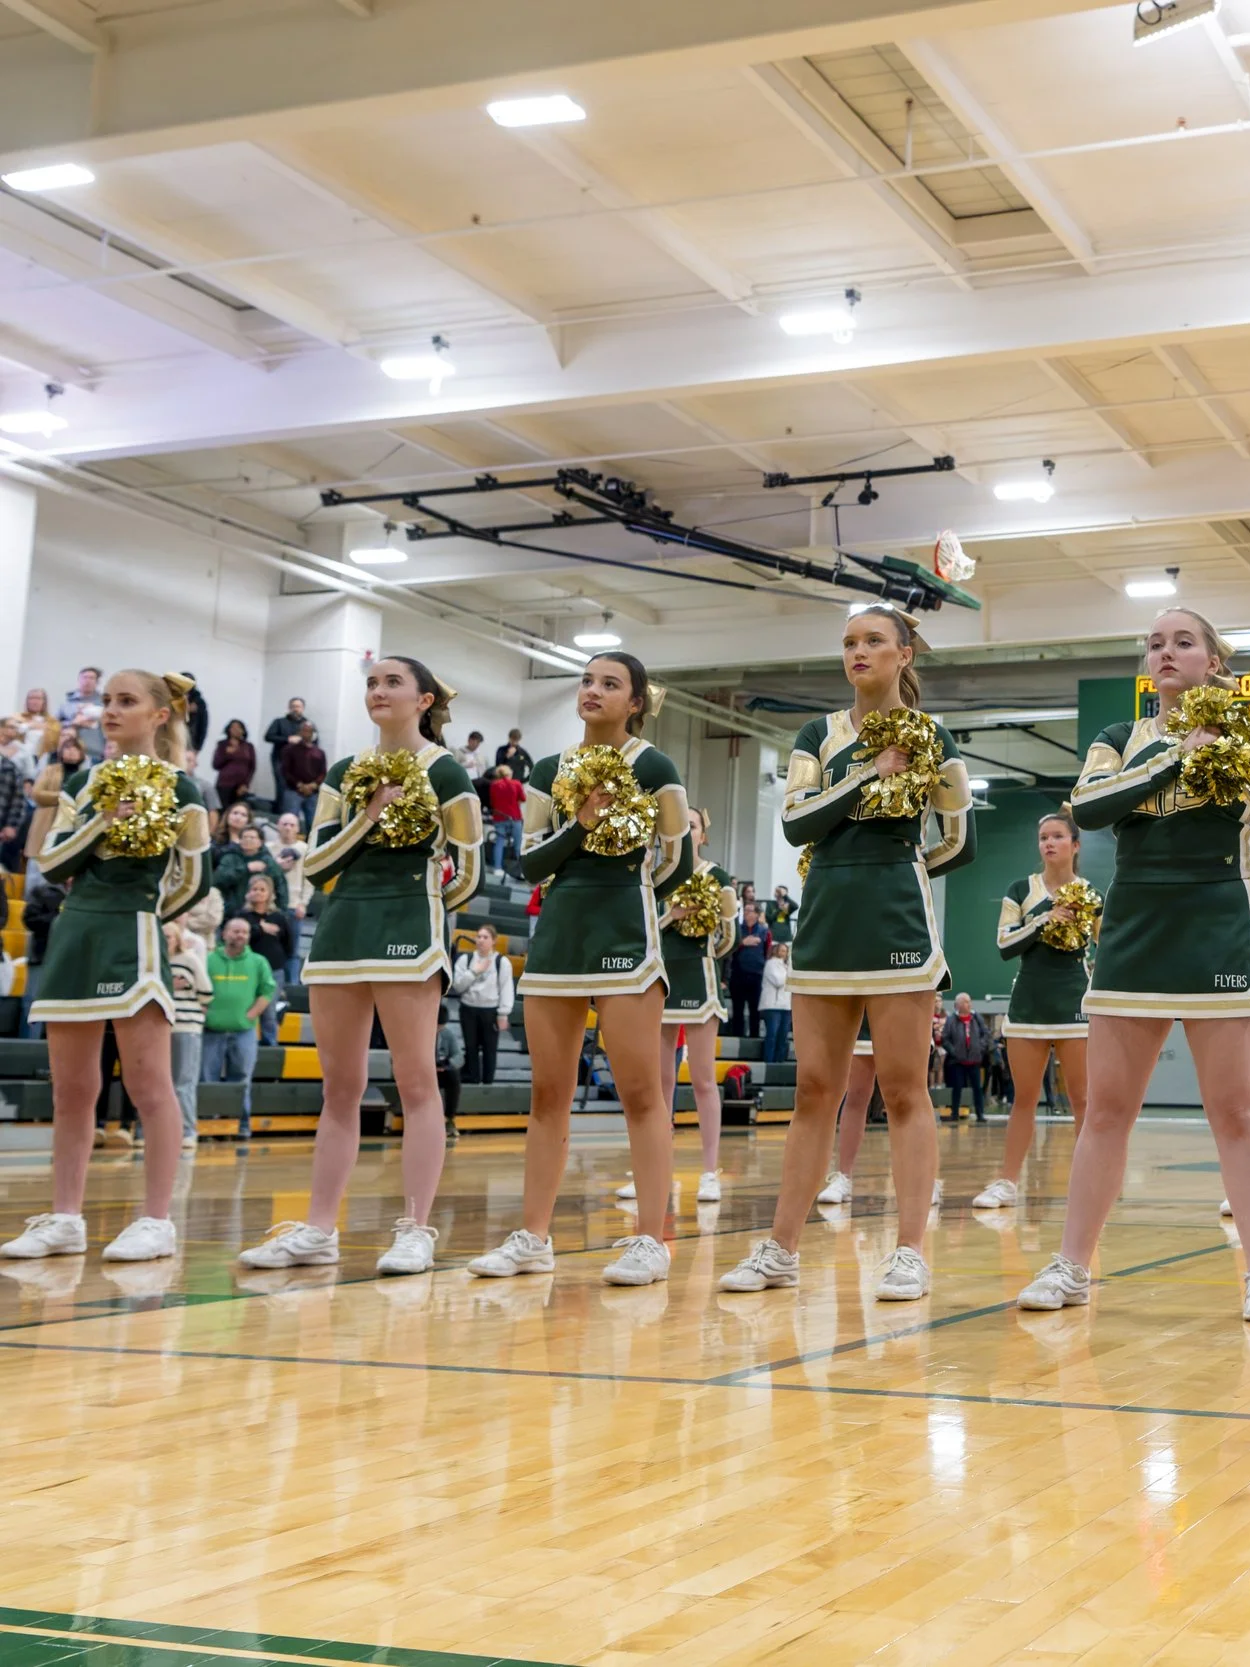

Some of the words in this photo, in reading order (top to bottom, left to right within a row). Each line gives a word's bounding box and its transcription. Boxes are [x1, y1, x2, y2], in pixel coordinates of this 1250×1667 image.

[386, 944, 418, 956] FLYERS
[602, 957, 634, 969] FLYERS
[890, 951, 921, 965] FLYERS
[1214, 974, 1248, 988] FLYERS
